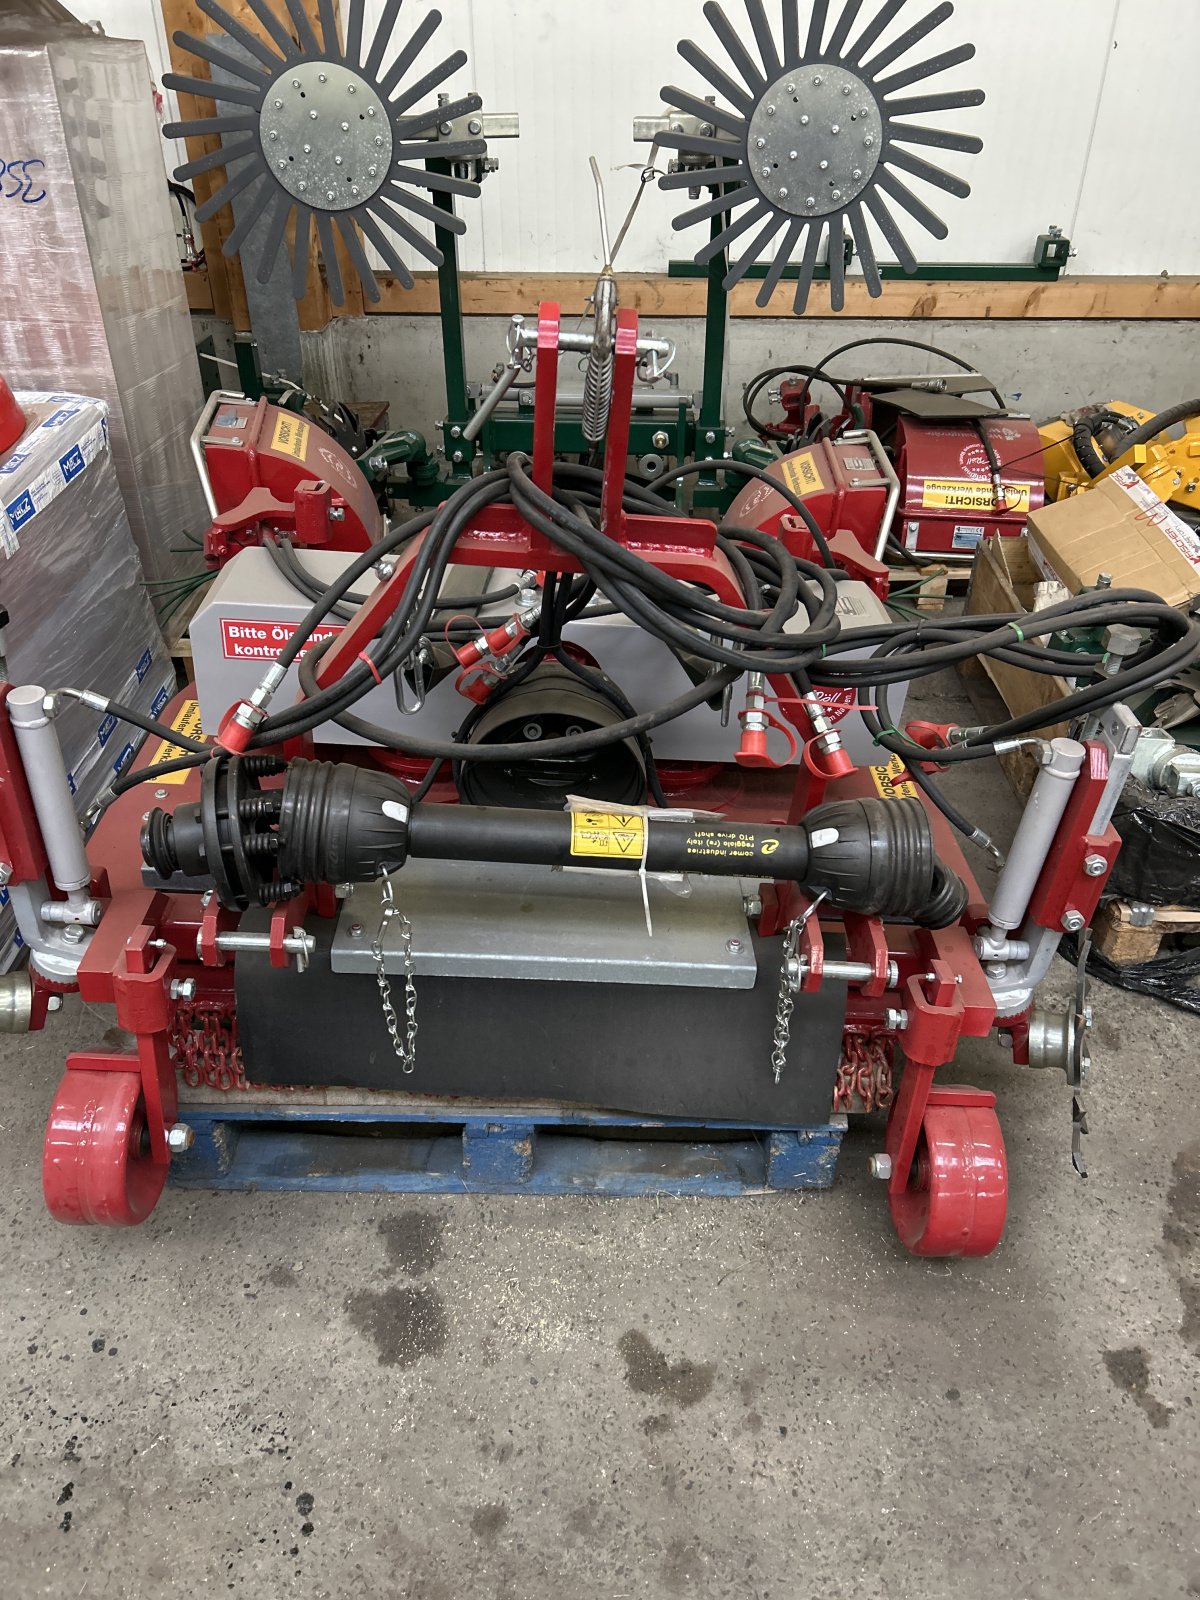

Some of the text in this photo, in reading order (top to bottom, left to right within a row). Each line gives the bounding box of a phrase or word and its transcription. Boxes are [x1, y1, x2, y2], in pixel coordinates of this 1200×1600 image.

[925, 483, 974, 494] Werkzeuge
[227, 626, 267, 639] Bitte
[687, 847, 727, 857] industries
